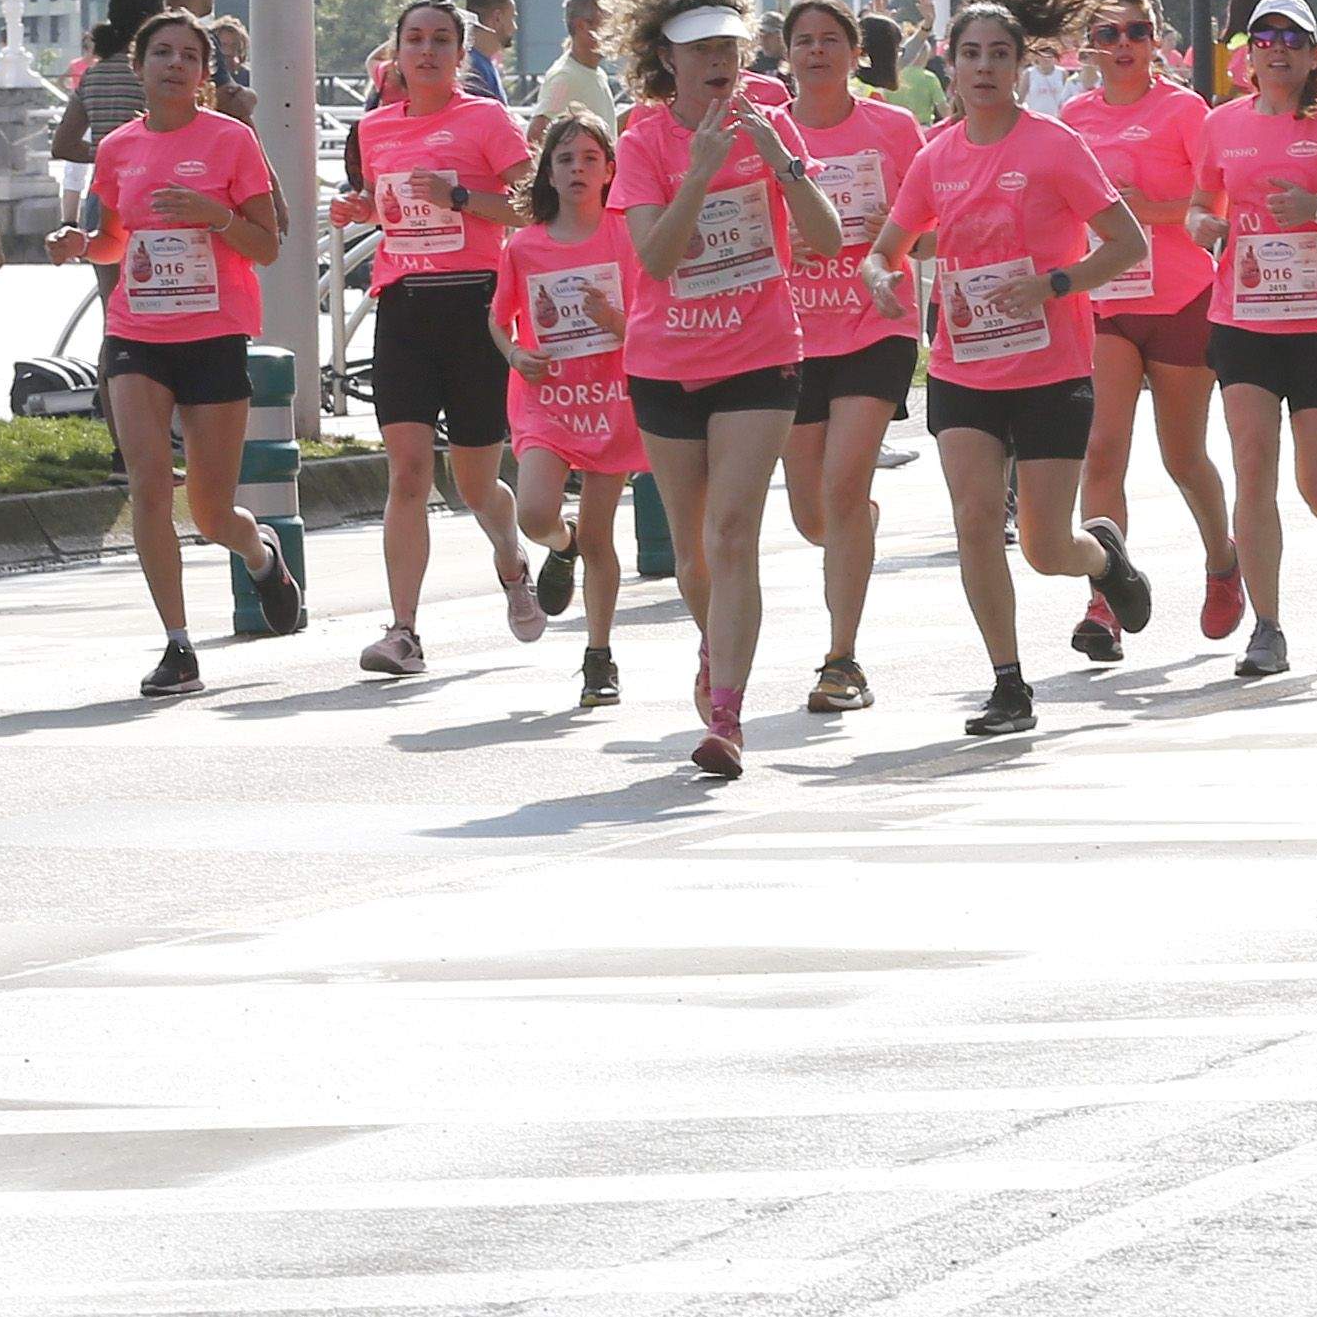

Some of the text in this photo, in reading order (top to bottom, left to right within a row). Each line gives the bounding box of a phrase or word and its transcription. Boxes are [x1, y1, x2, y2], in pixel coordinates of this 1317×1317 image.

[831, 192, 852, 204] 16
[403, 204, 431, 217] 016
[707, 227, 740, 247] 016
[154, 262, 184, 275] 016
[1263, 267, 1292, 281] 016
[791, 287, 861, 309] SUMA
[560, 304, 580, 318] 01
[666, 306, 743, 329] SUMA
[539, 380, 631, 406] DORSAL
